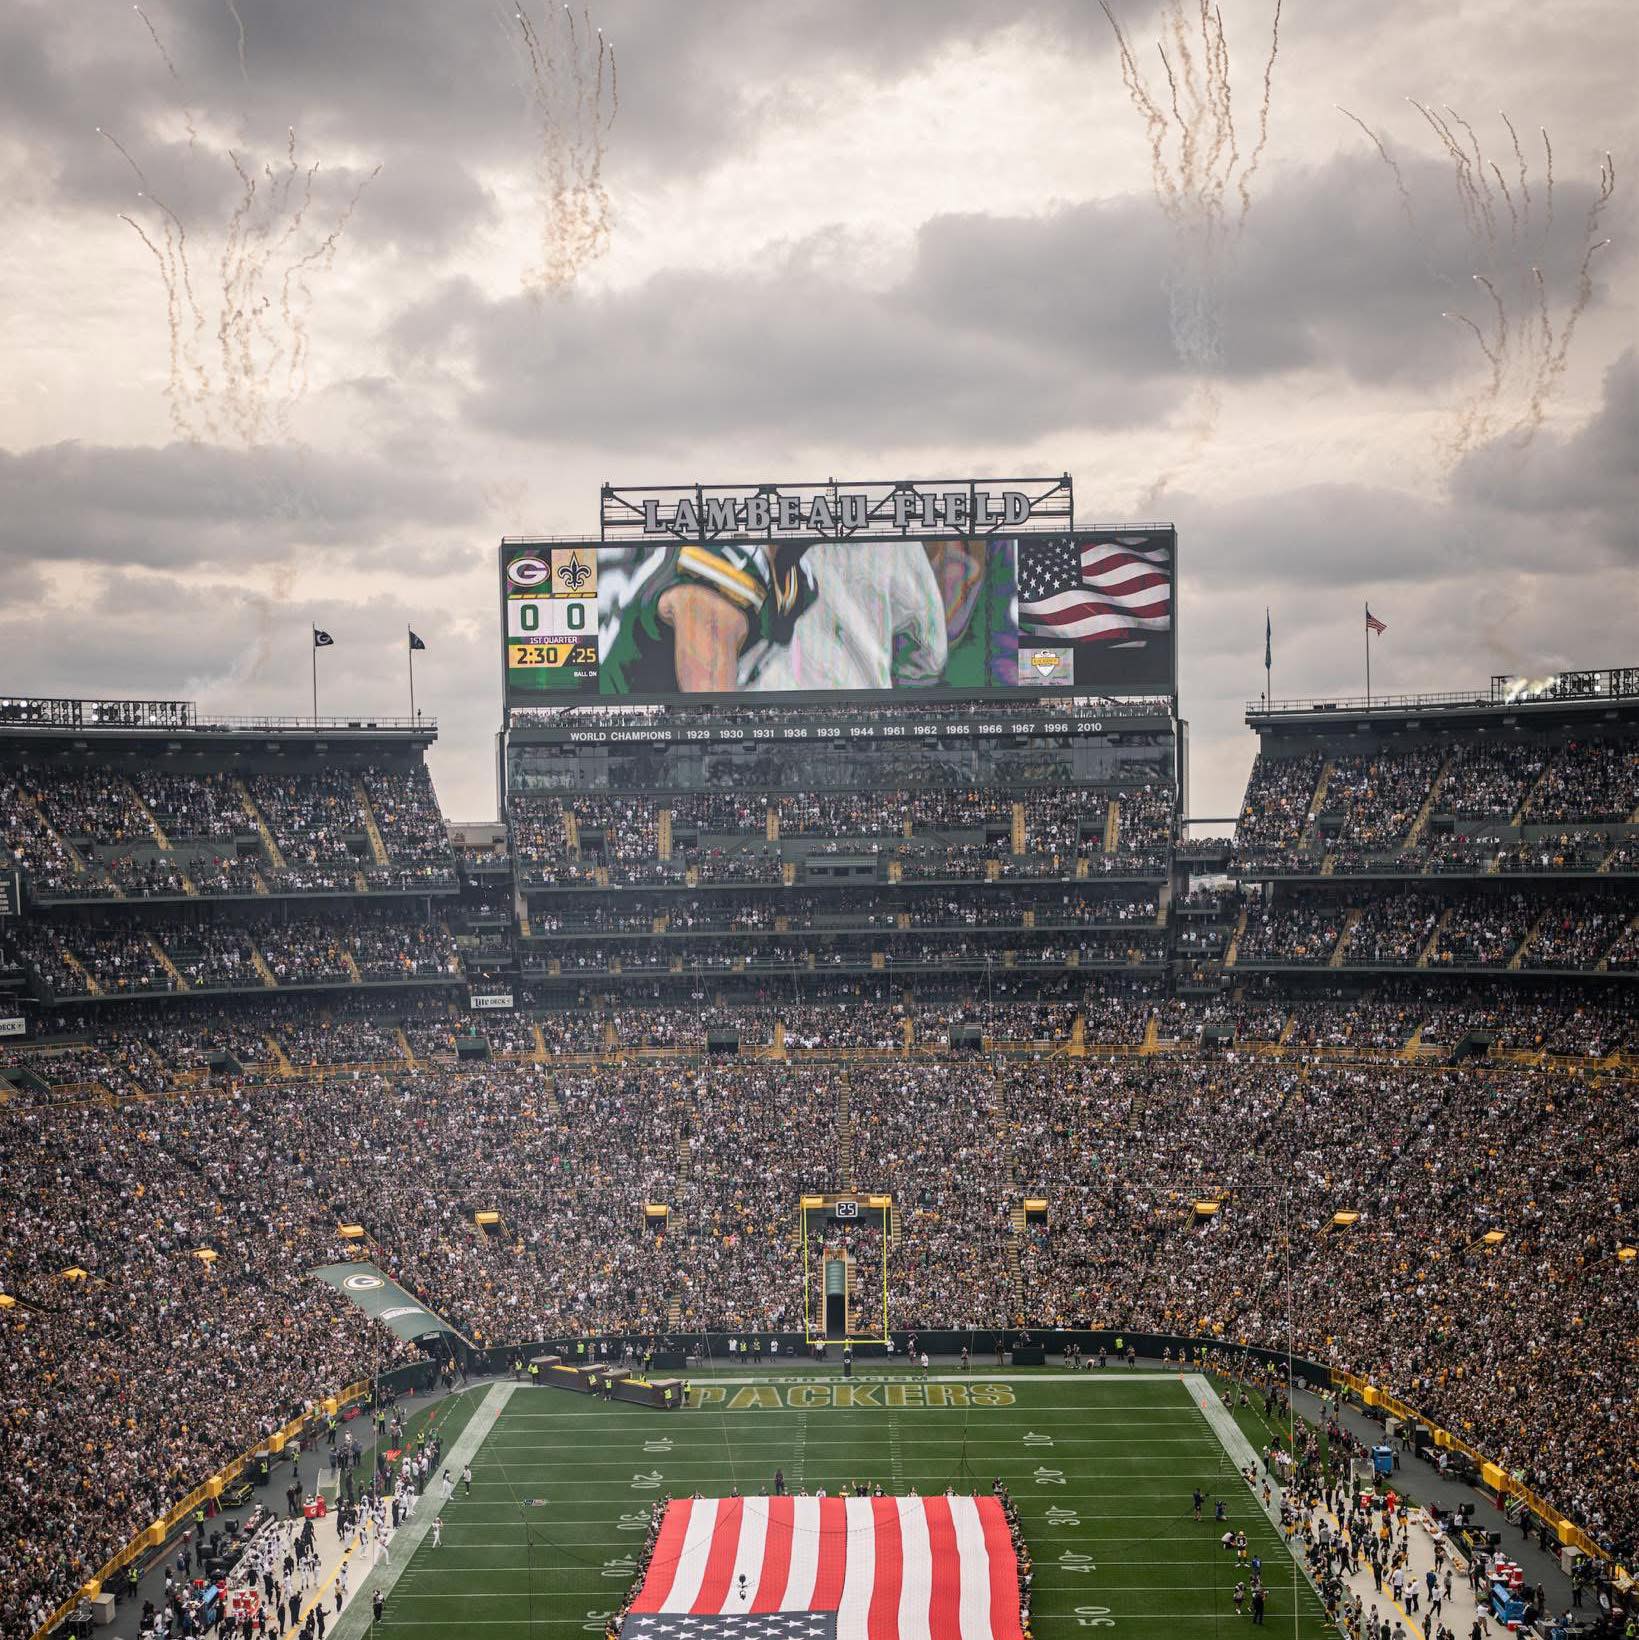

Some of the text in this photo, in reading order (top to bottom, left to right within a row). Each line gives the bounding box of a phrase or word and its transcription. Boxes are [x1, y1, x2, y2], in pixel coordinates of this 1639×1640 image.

[643, 491, 1031, 533] LAMBEAU FIELD
[520, 603, 585, 631] 0 0
[545, 636, 578, 644] QUARTER
[517, 647, 558, 665] 2:30
[570, 722, 1102, 741] WORLD CHAMPIONS 1929 1930 1931 1936 1939 1944 1961 1962 1965 1966 1967 1996 2010
[839, 1203, 855, 1215] 25
[680, 1384, 1016, 1409] PACKERS
[1074, 1606, 1115, 1627] 50
